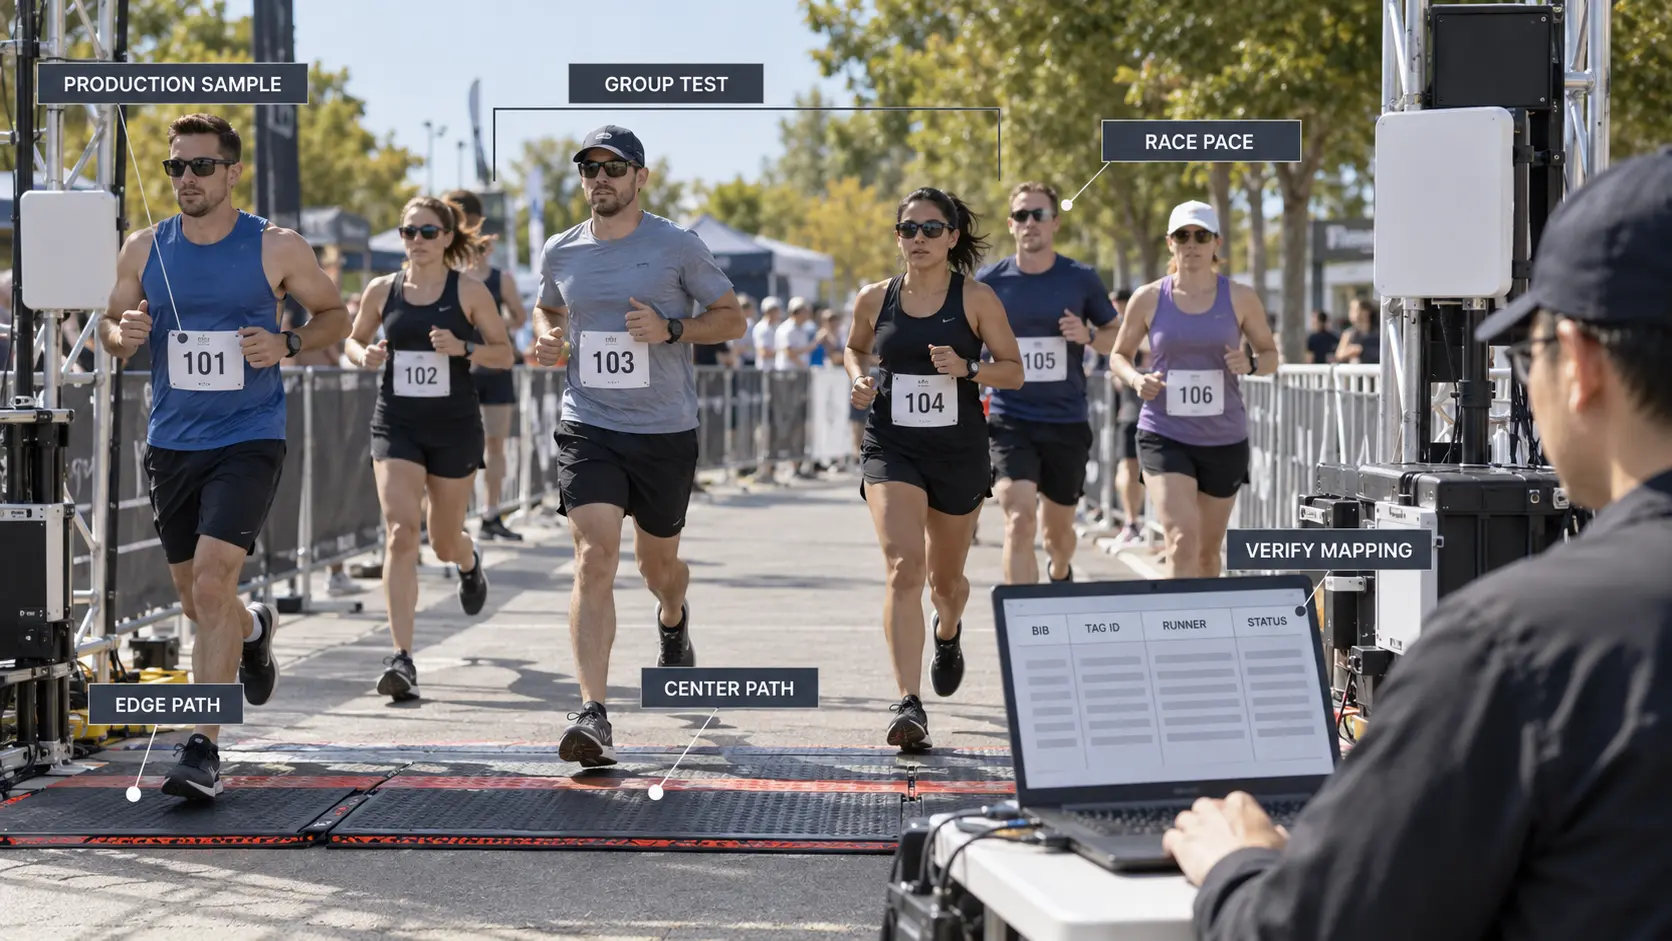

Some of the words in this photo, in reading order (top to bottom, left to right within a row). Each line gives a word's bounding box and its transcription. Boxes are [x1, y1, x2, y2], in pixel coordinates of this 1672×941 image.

[183, 351, 225, 375] 101
[593, 350, 635, 374] 103
[1024, 352, 1056, 370] 105
[405, 366, 438, 385] 102
[905, 392, 945, 413] 104
[1179, 386, 1213, 404] 106
[1031, 625, 1050, 636] BIB
[1085, 622, 1107, 633] TAG
[1108, 622, 1120, 632] ID
[1162, 619, 1207, 630] RUNNER
[1247, 616, 1288, 627] STATUS
